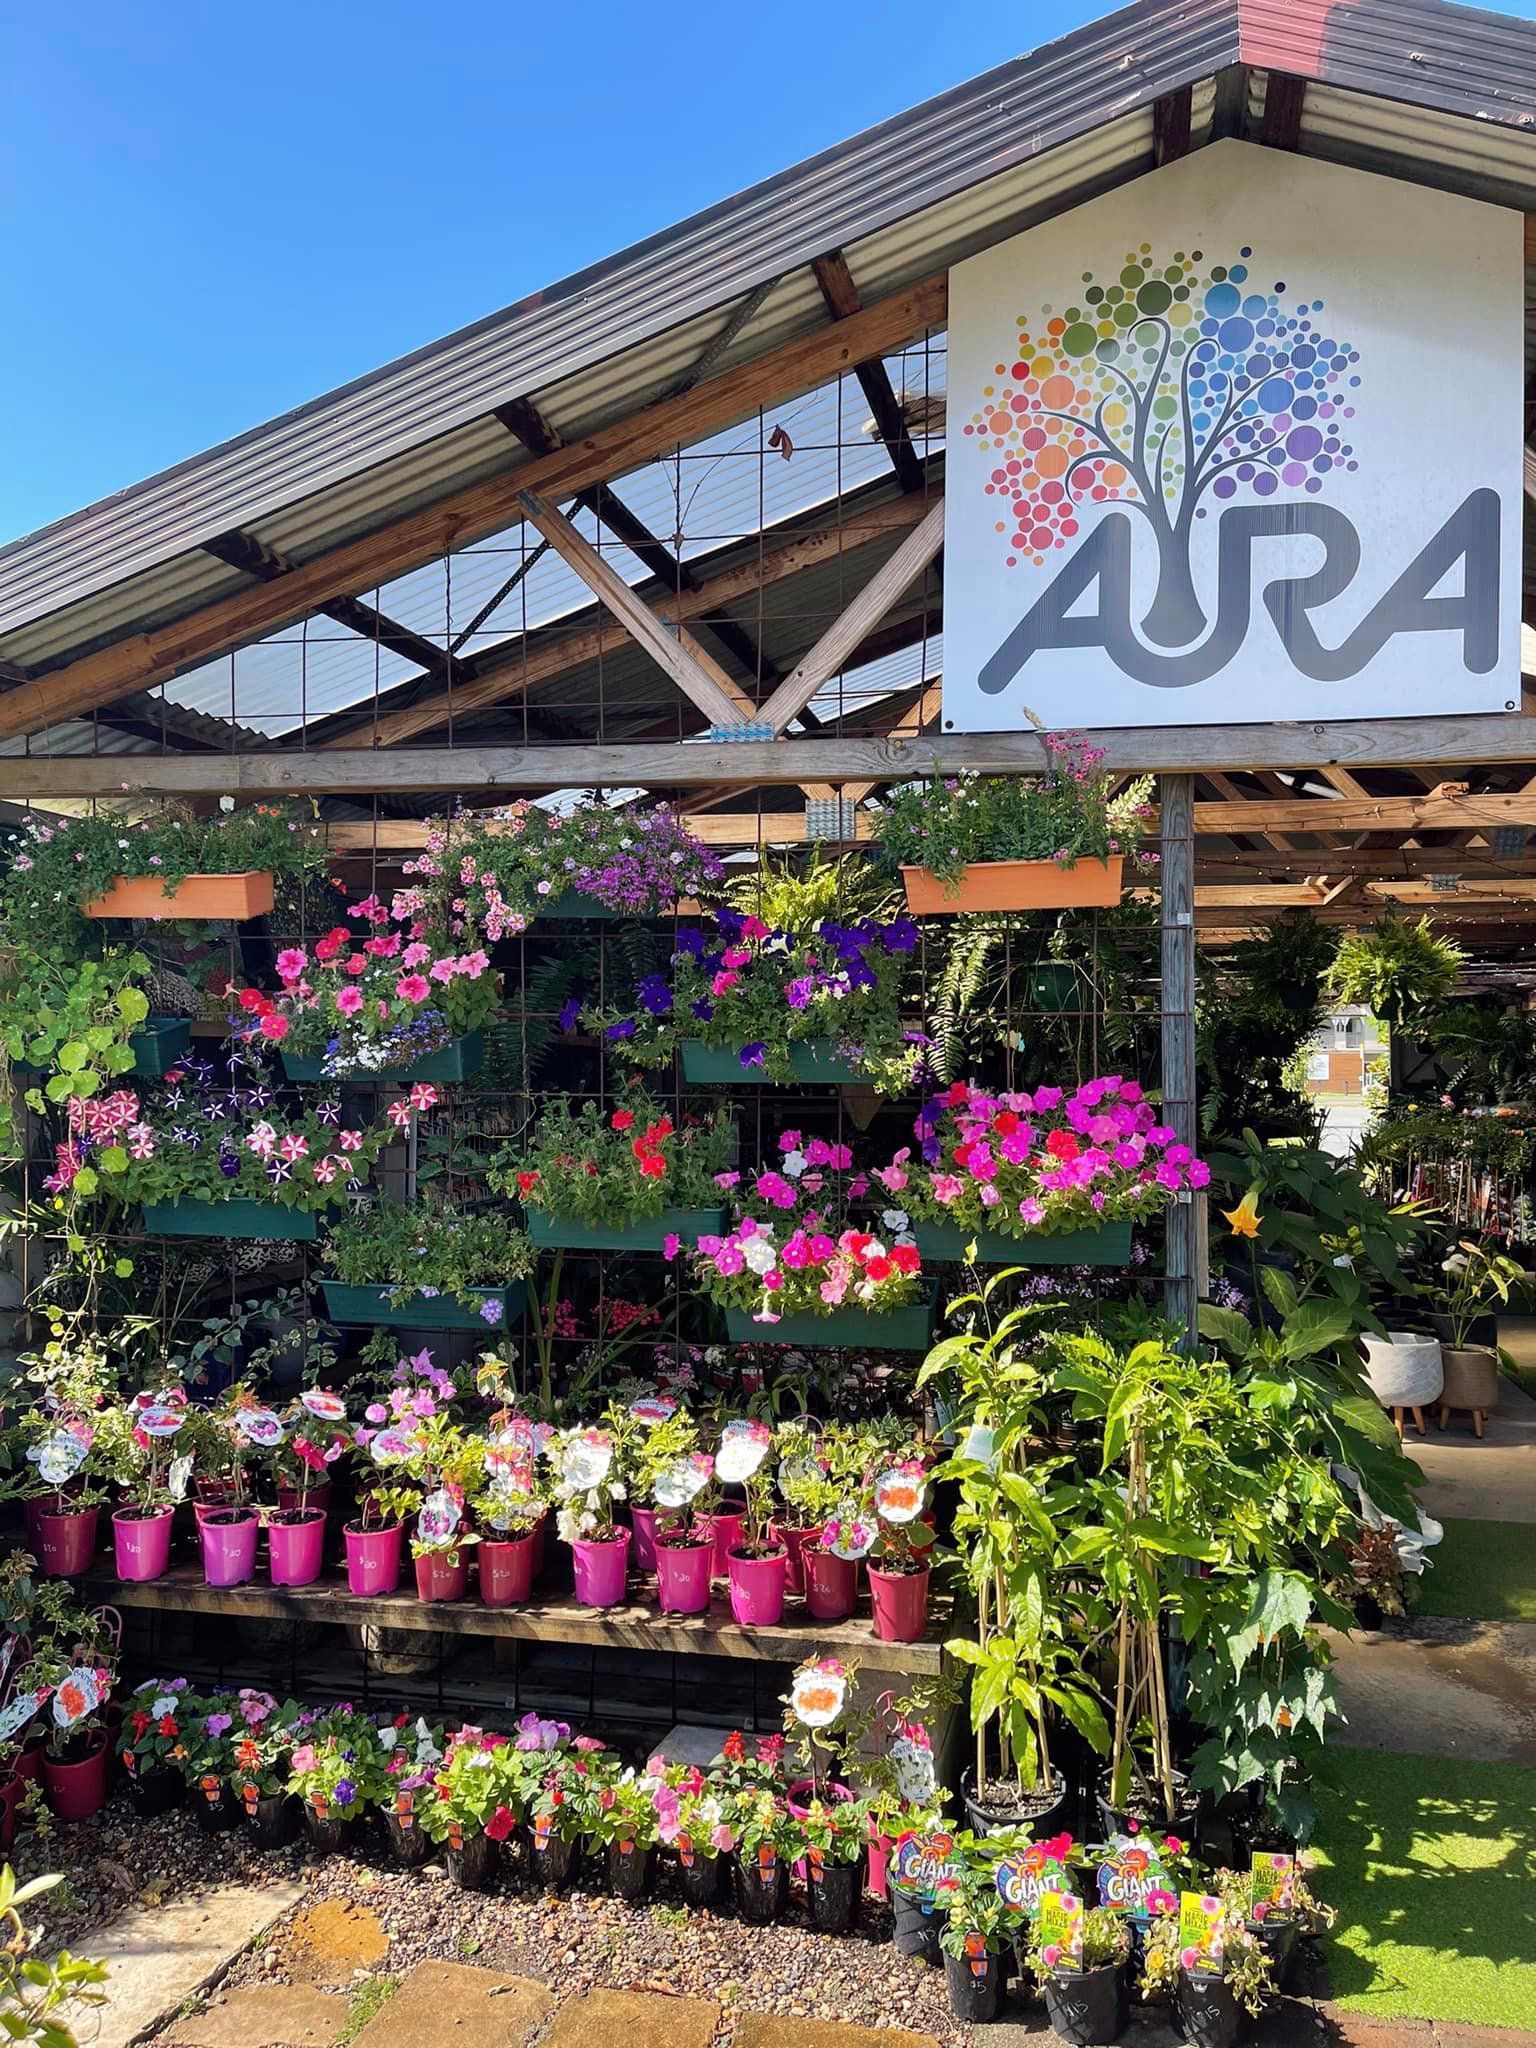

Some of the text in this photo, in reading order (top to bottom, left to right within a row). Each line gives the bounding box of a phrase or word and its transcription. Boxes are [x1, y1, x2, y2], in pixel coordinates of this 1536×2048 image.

[977, 487, 1501, 695] AURA
[904, 1854, 962, 1880] GIANT
[1006, 1874, 1062, 1904] GIANT
[1107, 1875, 1165, 1901] GIANT
